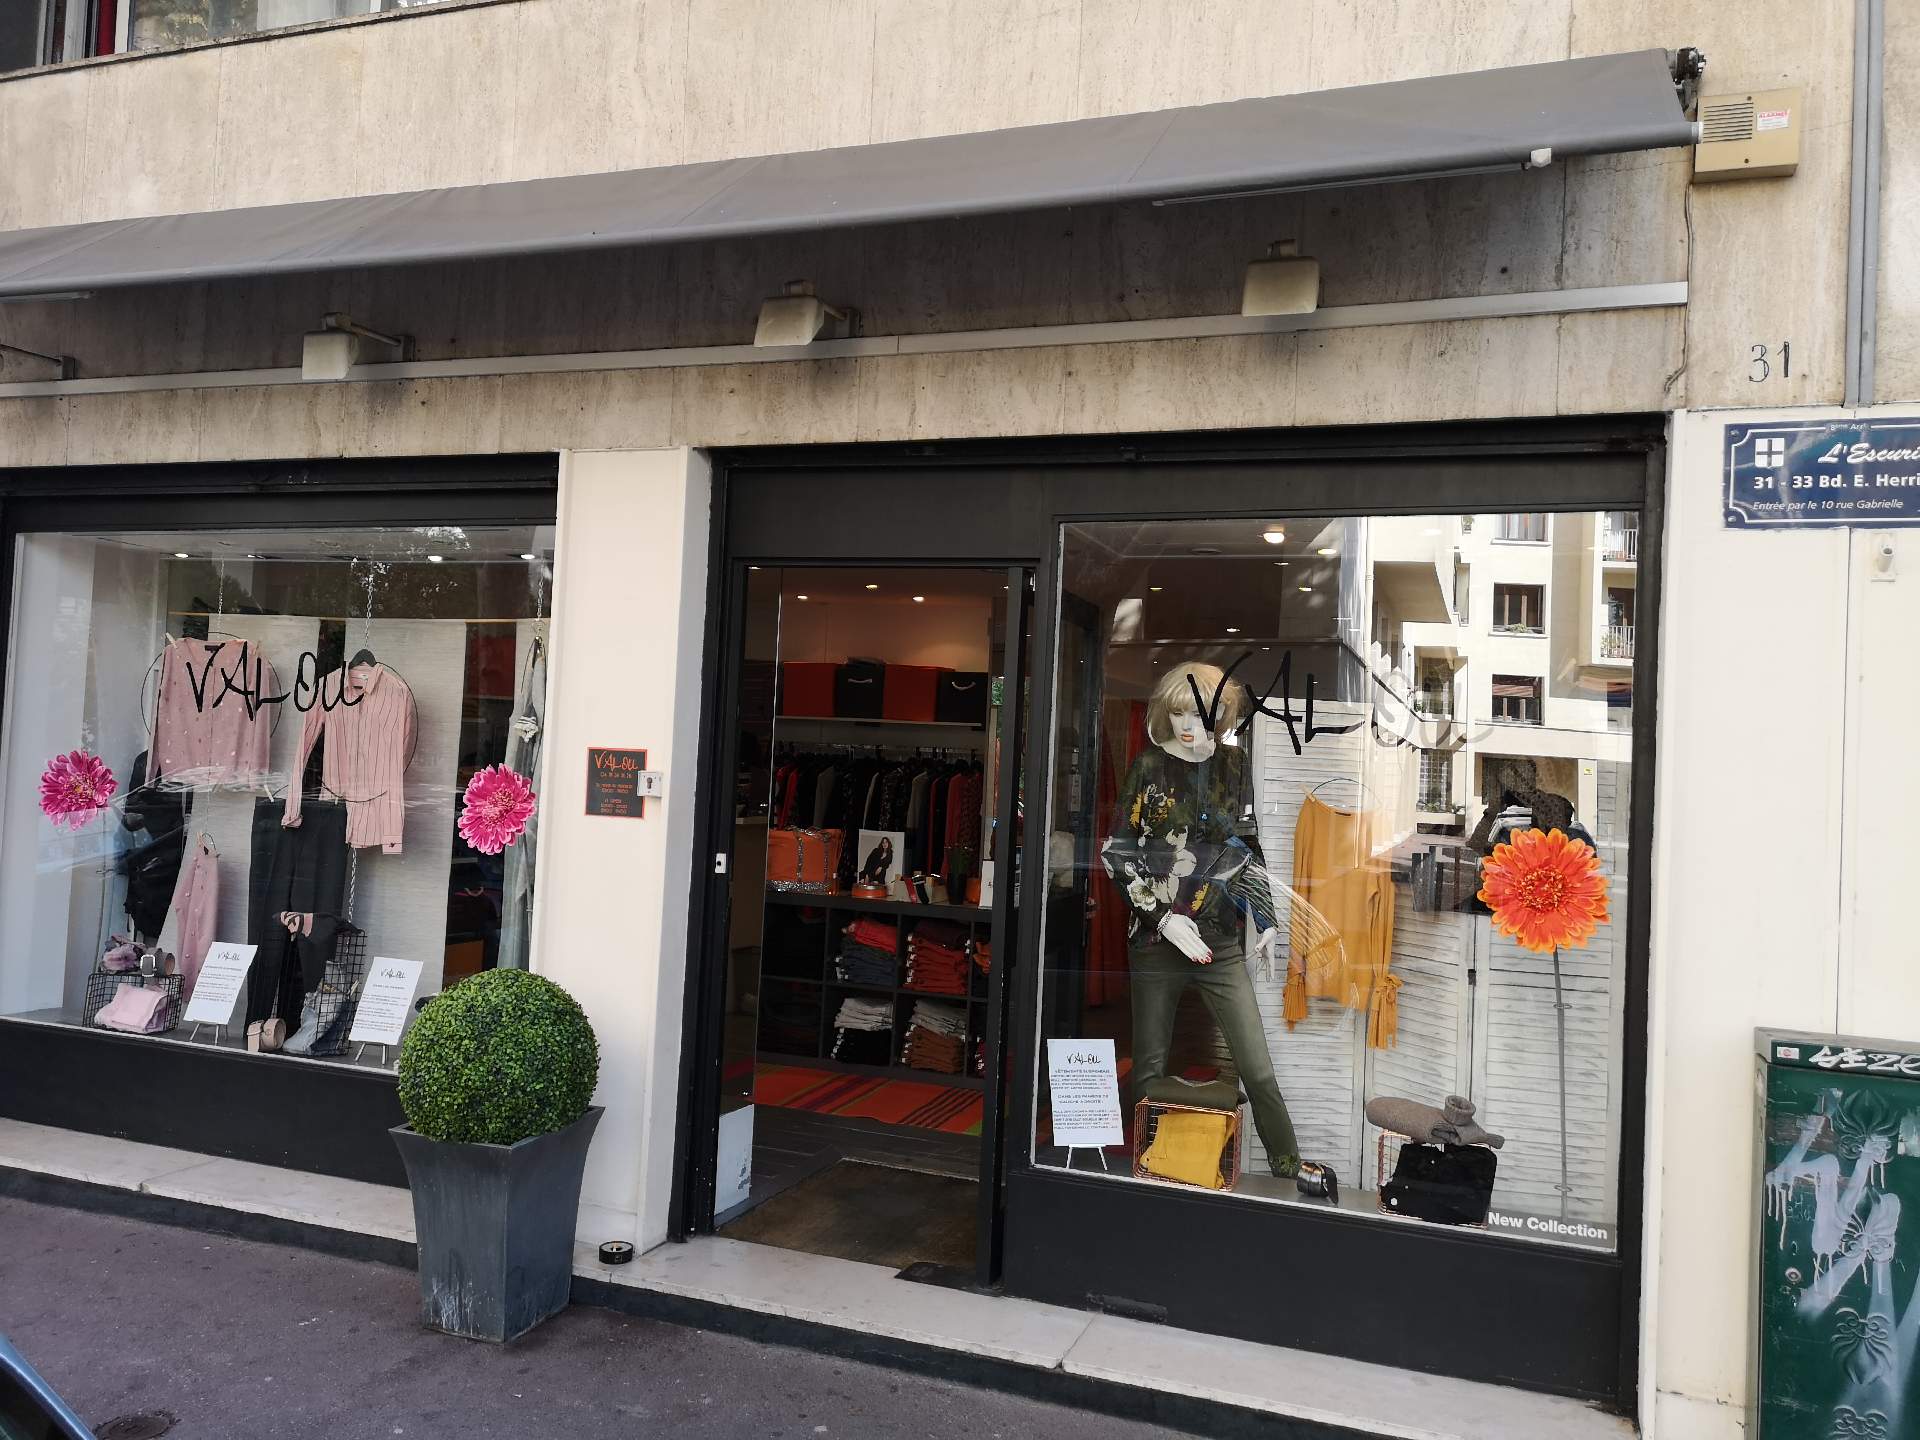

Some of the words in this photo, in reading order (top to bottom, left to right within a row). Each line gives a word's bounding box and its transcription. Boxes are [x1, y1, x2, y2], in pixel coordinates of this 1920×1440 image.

[1748, 341, 1790, 383] 31
[1753, 476, 1774, 489] 31
[1792, 475, 1814, 488] 33
[1818, 473, 1847, 488] Bd.
[1853, 474, 1869, 487] E.
[1752, 500, 1785, 511] Entrée
[1786, 502, 1806, 512] par
[1807, 500, 1817, 510] le
[1821, 500, 1834, 509] 10
[1836, 501, 1853, 509] rue
[1856, 498, 1904, 510] Gabrielle
[1488, 1211, 1524, 1229] New
[1526, 1216, 1608, 1240] Collection
